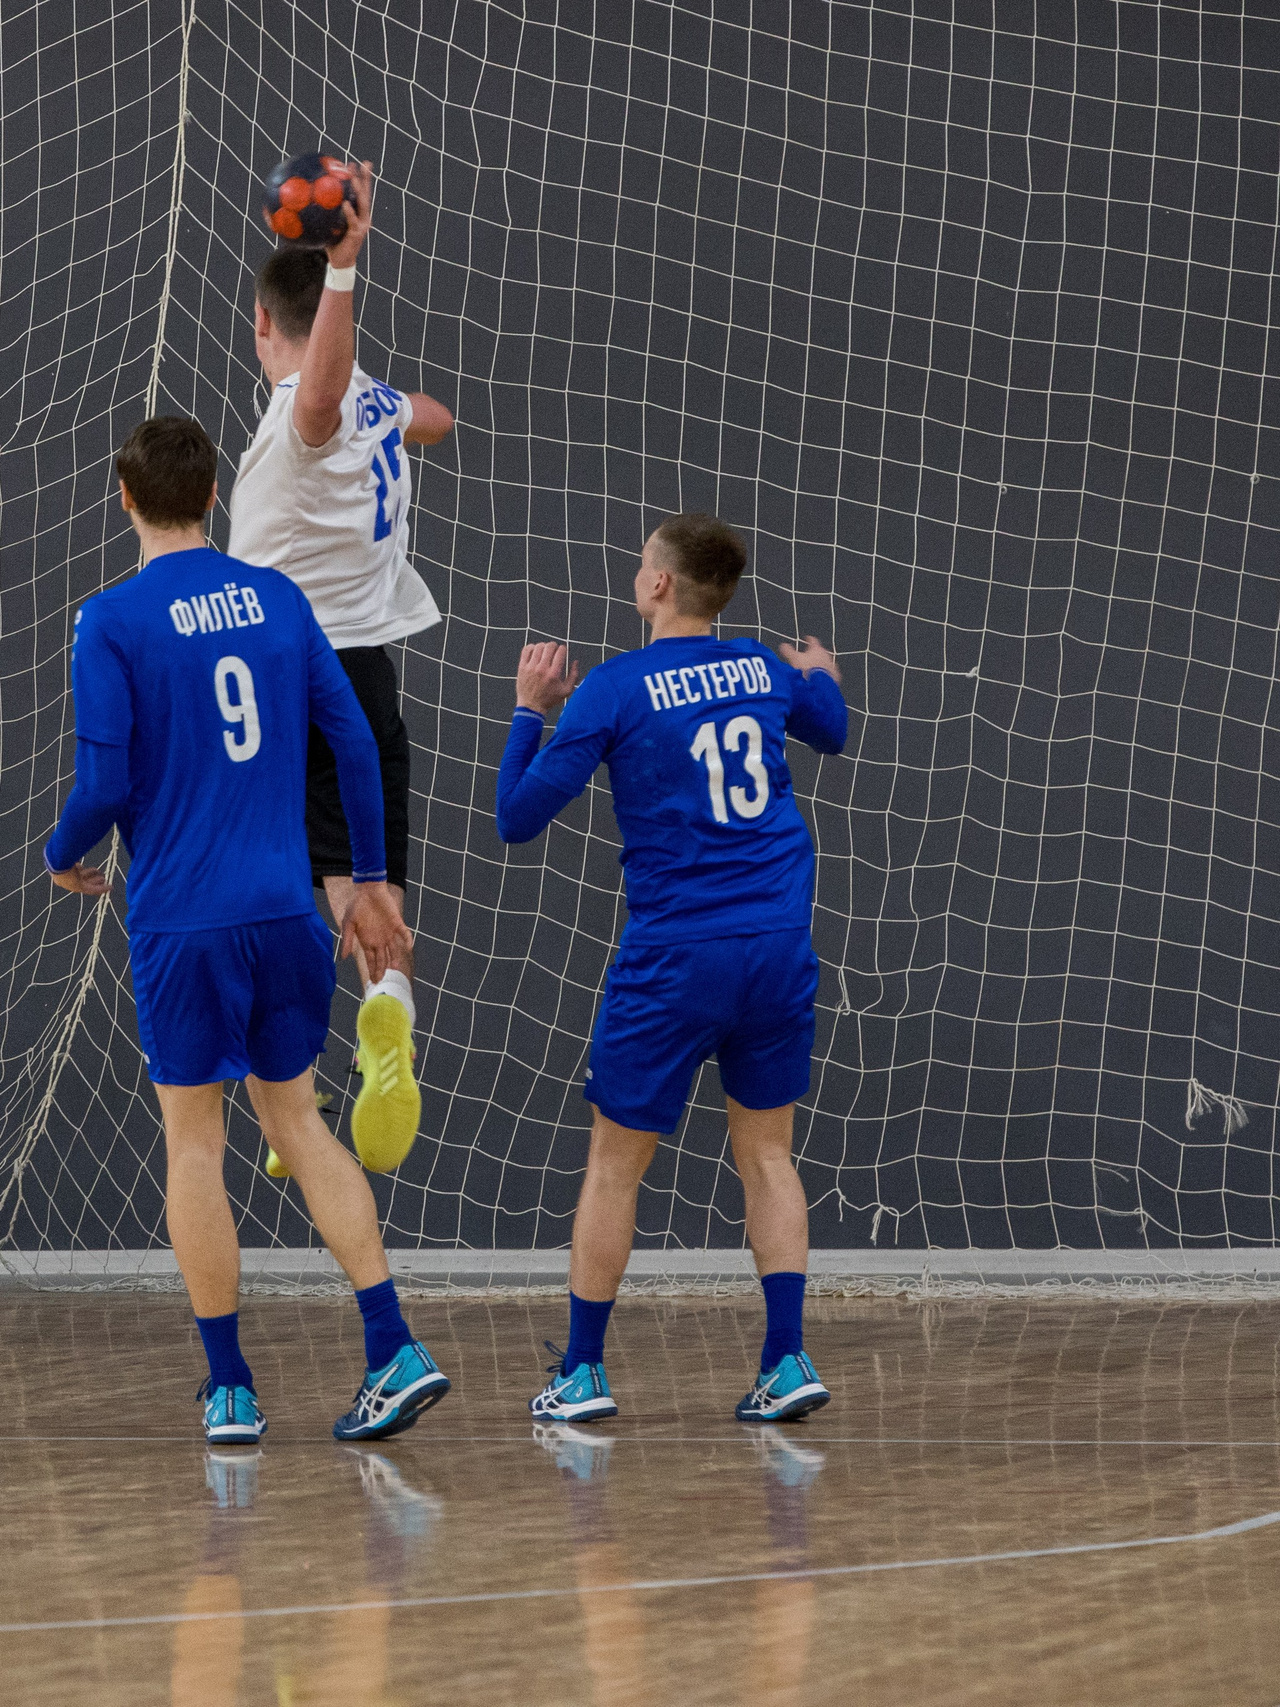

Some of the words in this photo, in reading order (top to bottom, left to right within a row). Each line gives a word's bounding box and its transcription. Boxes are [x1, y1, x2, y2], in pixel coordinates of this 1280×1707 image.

[168, 582, 265, 637] ФИЛЁВ
[214, 655, 261, 763] 9
[644, 656, 771, 711] НЕСТЕРОВ
[690, 715, 770, 824] 13
